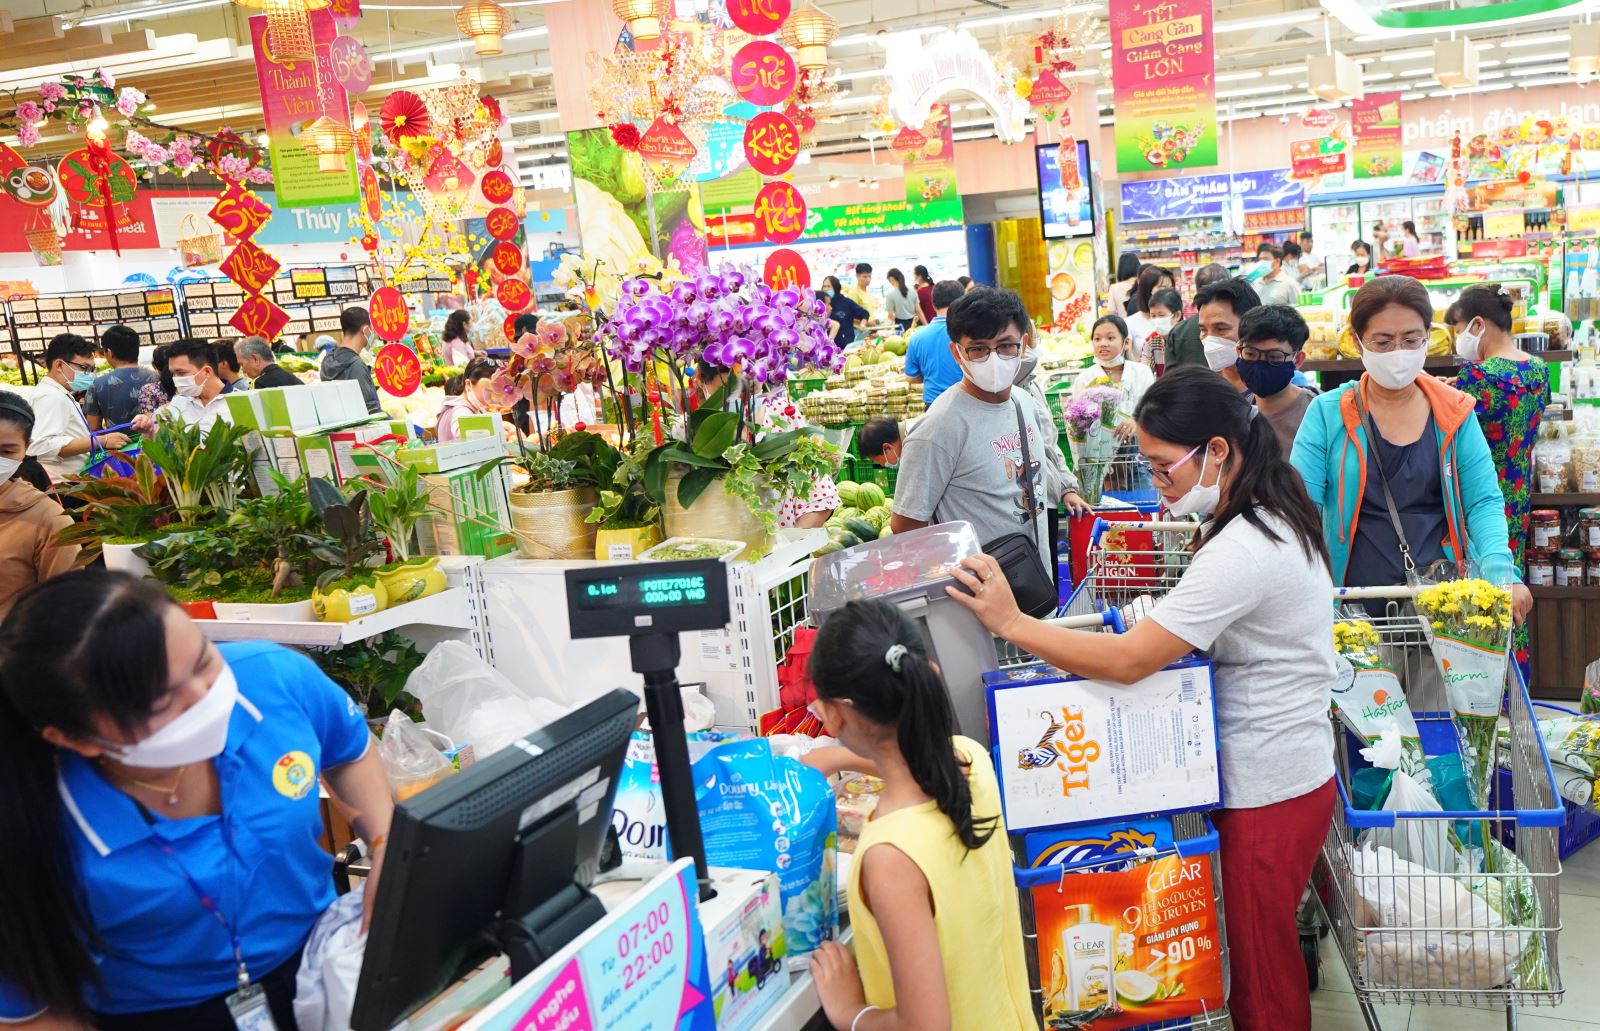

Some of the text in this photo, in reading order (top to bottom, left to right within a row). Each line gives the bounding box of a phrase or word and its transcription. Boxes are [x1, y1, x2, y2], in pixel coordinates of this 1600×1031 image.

[1143, 2, 1178, 24] TẾT
[1166, 21, 1194, 36] Gần
[1126, 49, 1162, 63] Giảm
[1144, 57, 1184, 79] LỚN
[269, 69, 312, 90] Thành
[282, 95, 315, 115] Viên
[1404, 108, 1475, 145] phẩm
[291, 207, 341, 234] Thủy
[1097, 567, 1136, 577] AIGON
[1056, 705, 1101, 797] Tiger
[719, 782, 760, 797] Downy
[1147, 863, 1202, 894] CLEAR
[618, 901, 670, 958] 07:00
[1123, 906, 1142, 934] 9
[1147, 933, 1165, 944] GIẢM
[1180, 920, 1199, 934] RỤNG
[1074, 941, 1105, 951] CLEAR
[623, 931, 673, 990] 22:00
